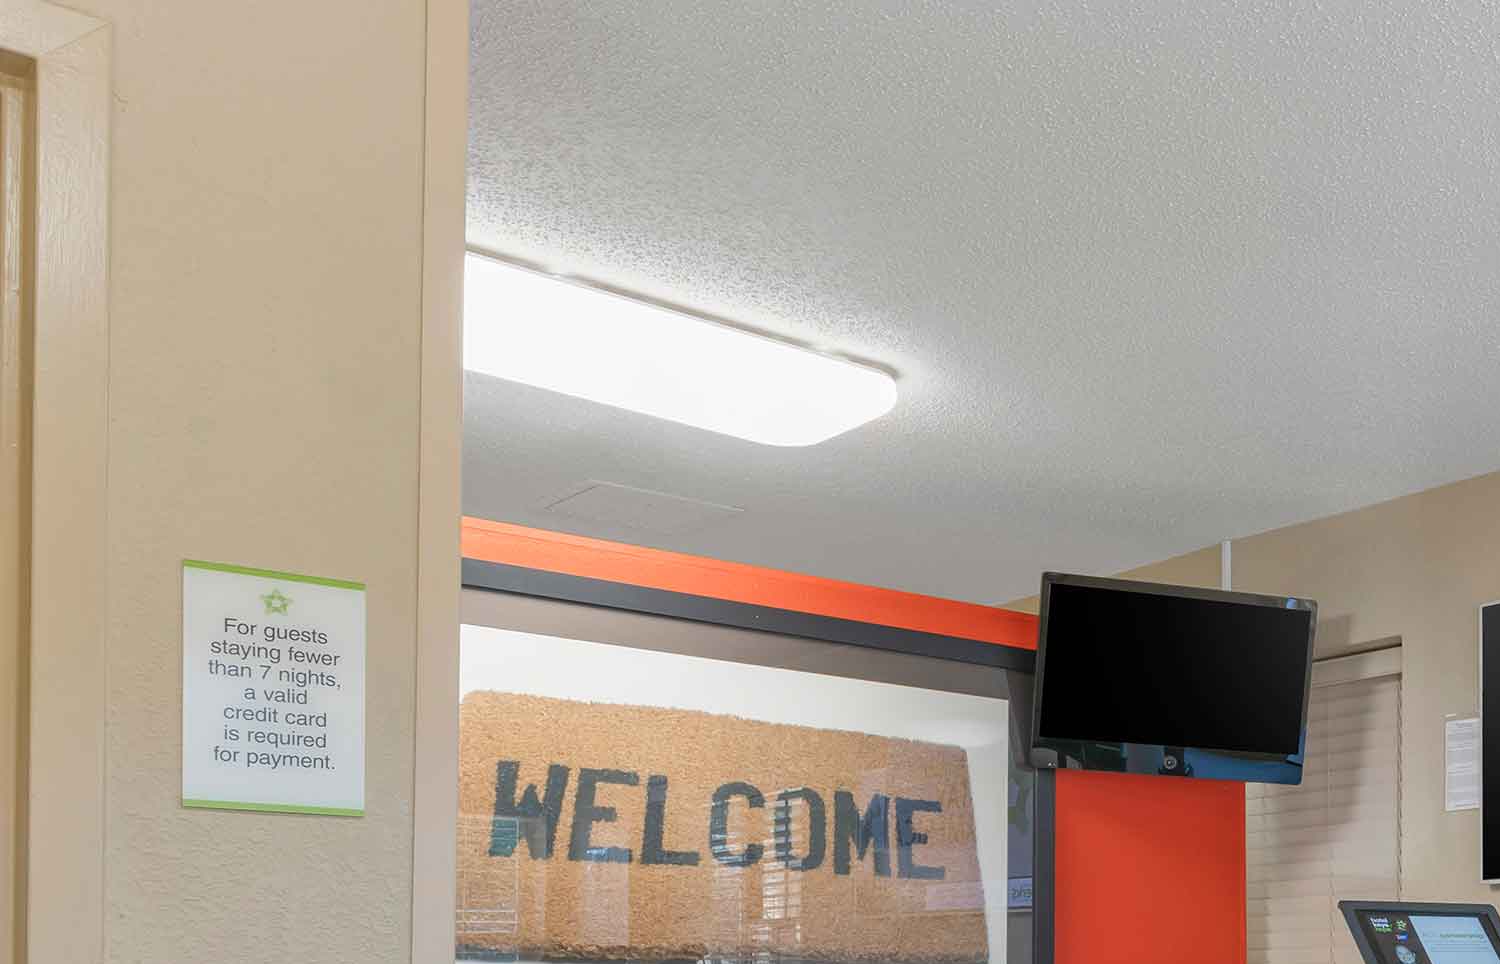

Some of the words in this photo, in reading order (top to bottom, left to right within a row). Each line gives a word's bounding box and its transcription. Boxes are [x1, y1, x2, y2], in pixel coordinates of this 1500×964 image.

[224, 617, 257, 636] For
[264, 625, 328, 645] guests
[210, 640, 281, 663] staying
[288, 646, 341, 666] fewer
[208, 659, 252, 678] than
[259, 665, 272, 679] 7
[279, 668, 342, 690] nights,
[244, 688, 256, 701] a
[264, 688, 308, 705] valid
[223, 706, 279, 723] credit
[285, 711, 328, 728] card
[224, 724, 240, 741] is
[247, 730, 327, 748] required
[214, 746, 240, 762] for
[247, 750, 336, 770] payment.
[487, 760, 945, 881] WELCOME
